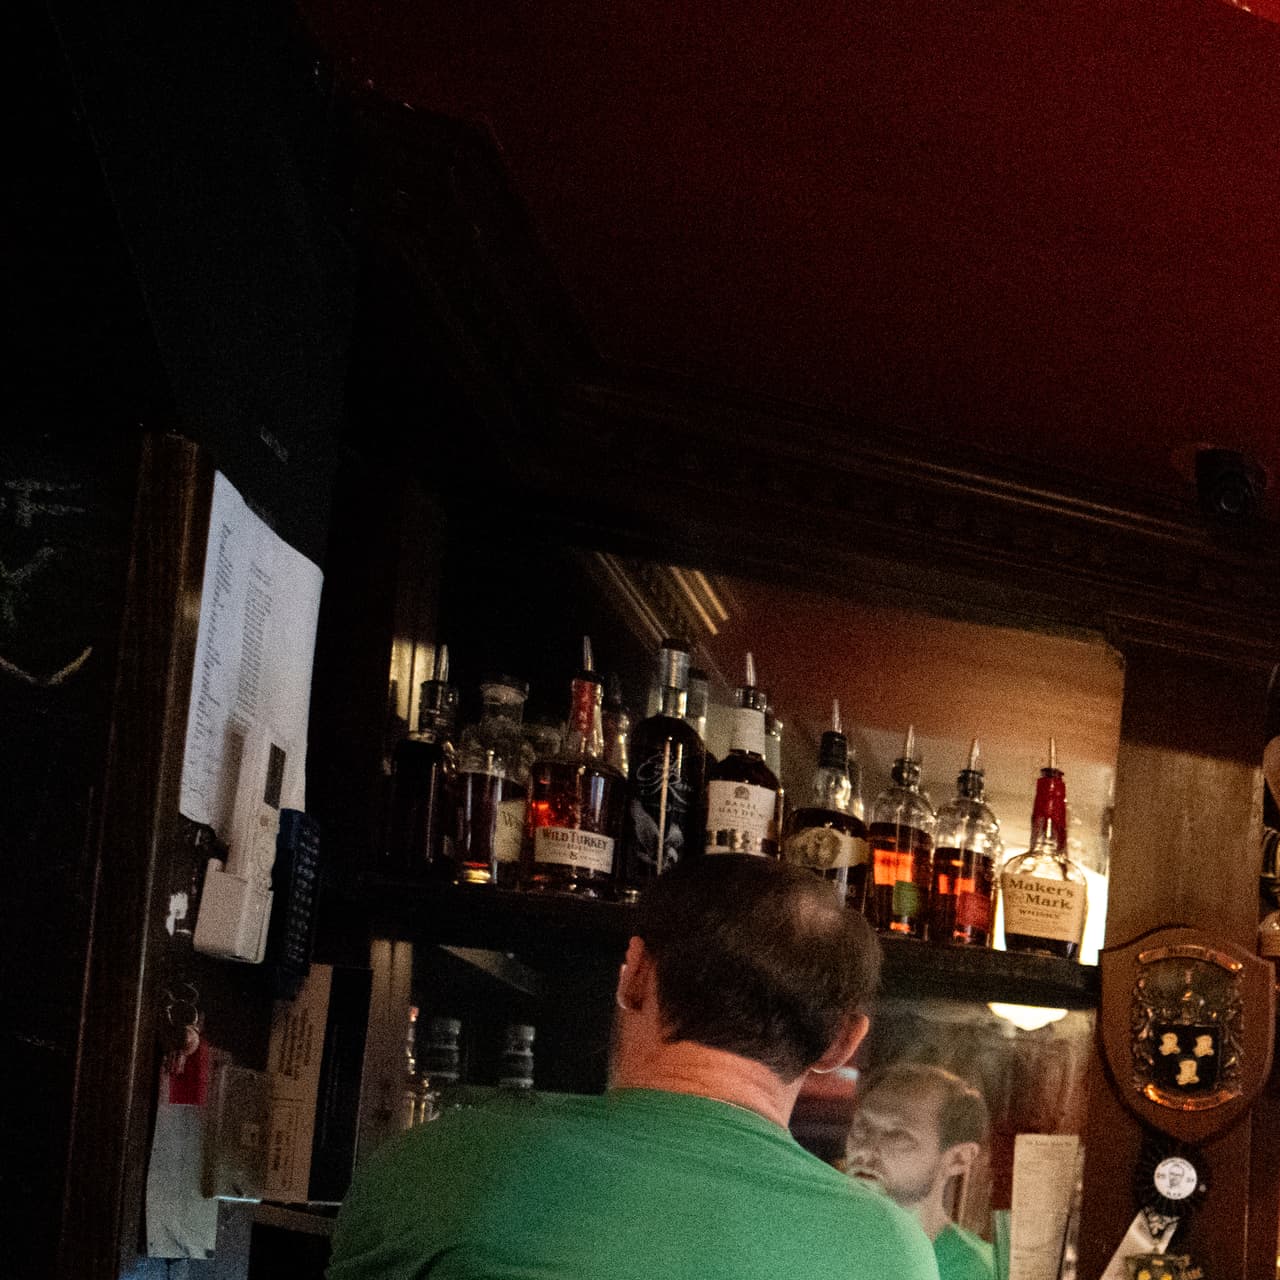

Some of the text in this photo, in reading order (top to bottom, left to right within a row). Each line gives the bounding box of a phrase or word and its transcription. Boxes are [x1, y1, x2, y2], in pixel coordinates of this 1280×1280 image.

[541, 829, 608, 850] WILD TURKEY
[1010, 879, 1074, 898] Maker's
[1026, 893, 1073, 910] Mark
